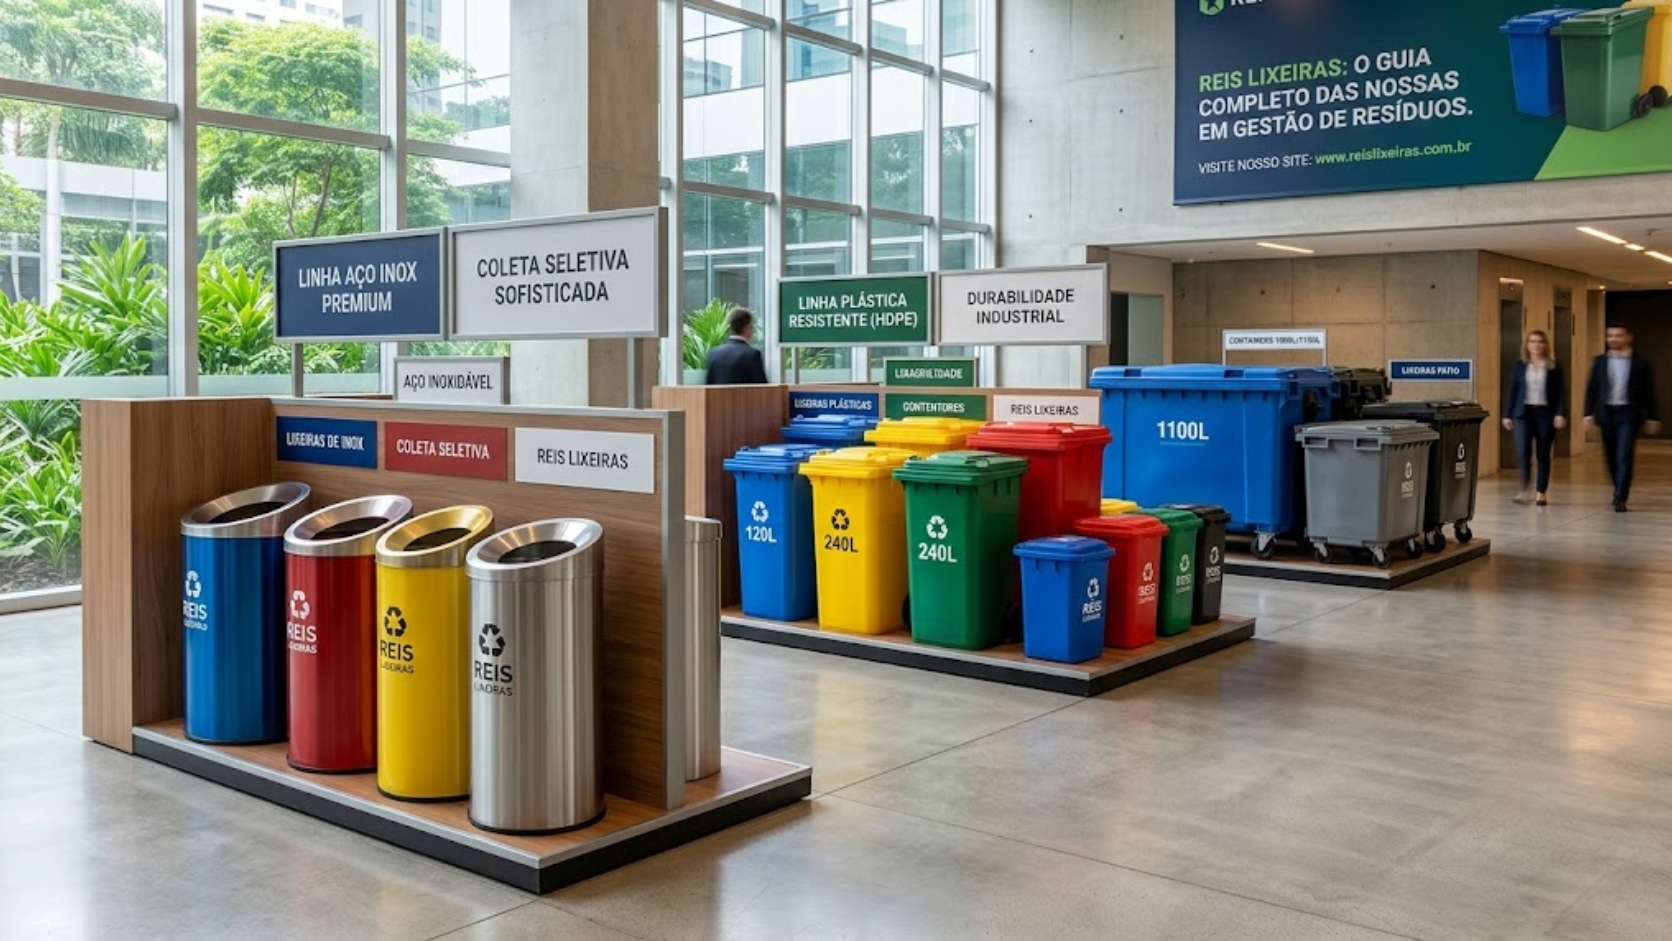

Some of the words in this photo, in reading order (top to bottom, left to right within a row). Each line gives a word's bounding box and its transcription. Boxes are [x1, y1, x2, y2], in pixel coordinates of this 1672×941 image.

[1199, 70, 1243, 93] REIS
[1248, 58, 1348, 87] LIXEIRAS:
[1353, 54, 1370, 75] O
[1376, 47, 1432, 72] GUIA
[1199, 87, 1310, 117] COMPLETO
[1315, 82, 1359, 105] DAS
[1365, 70, 1460, 99] NOSSAS
[1199, 121, 1228, 141] EM
[1233, 110, 1314, 138] GESTÃO
[1319, 109, 1348, 130] DE
[1352, 96, 1474, 126] RESÍDUOS.
[1198, 159, 1235, 174] VISITE
[1237, 156, 1280, 171] NOSSO
[1282, 153, 1313, 168] SITE:
[1314, 140, 1473, 165] www.reislixeiras.com.br
[476, 254, 541, 279] COLETA
[545, 248, 630, 275] SELETIVA
[298, 265, 342, 289] LINHA
[344, 263, 377, 290] AÇO
[379, 260, 418, 284] INOX
[321, 290, 393, 314] PREMIUM
[494, 280, 610, 306] SOFISTICADA
[798, 295, 839, 311] LINHA
[840, 290, 908, 309] PLÁSTICA
[966, 287, 1076, 306] DURABILIDADE
[788, 313, 868, 329] RESISTENTE
[869, 310, 919, 331] (HDPE)
[976, 308, 1066, 325] INDUSTRIAL
[403, 374, 426, 392] AÇO
[427, 371, 494, 390] INOXIDÁVEL
[1010, 404, 1033, 416] REIS
[1157, 420, 1210, 440] 1100L
[396, 438, 437, 456] COLETA
[439, 441, 490, 460] SELETIVA
[537, 448, 566, 465] REIS
[568, 450, 629, 470] LIXEIRAS
[745, 525, 778, 544] 120L
[824, 534, 859, 554] 240L
[917, 542, 958, 563] 240L
[182, 599, 208, 621] REIS
[286, 621, 318, 643] REIS
[379, 639, 414, 662] REIS
[474, 660, 513, 684] REIS
